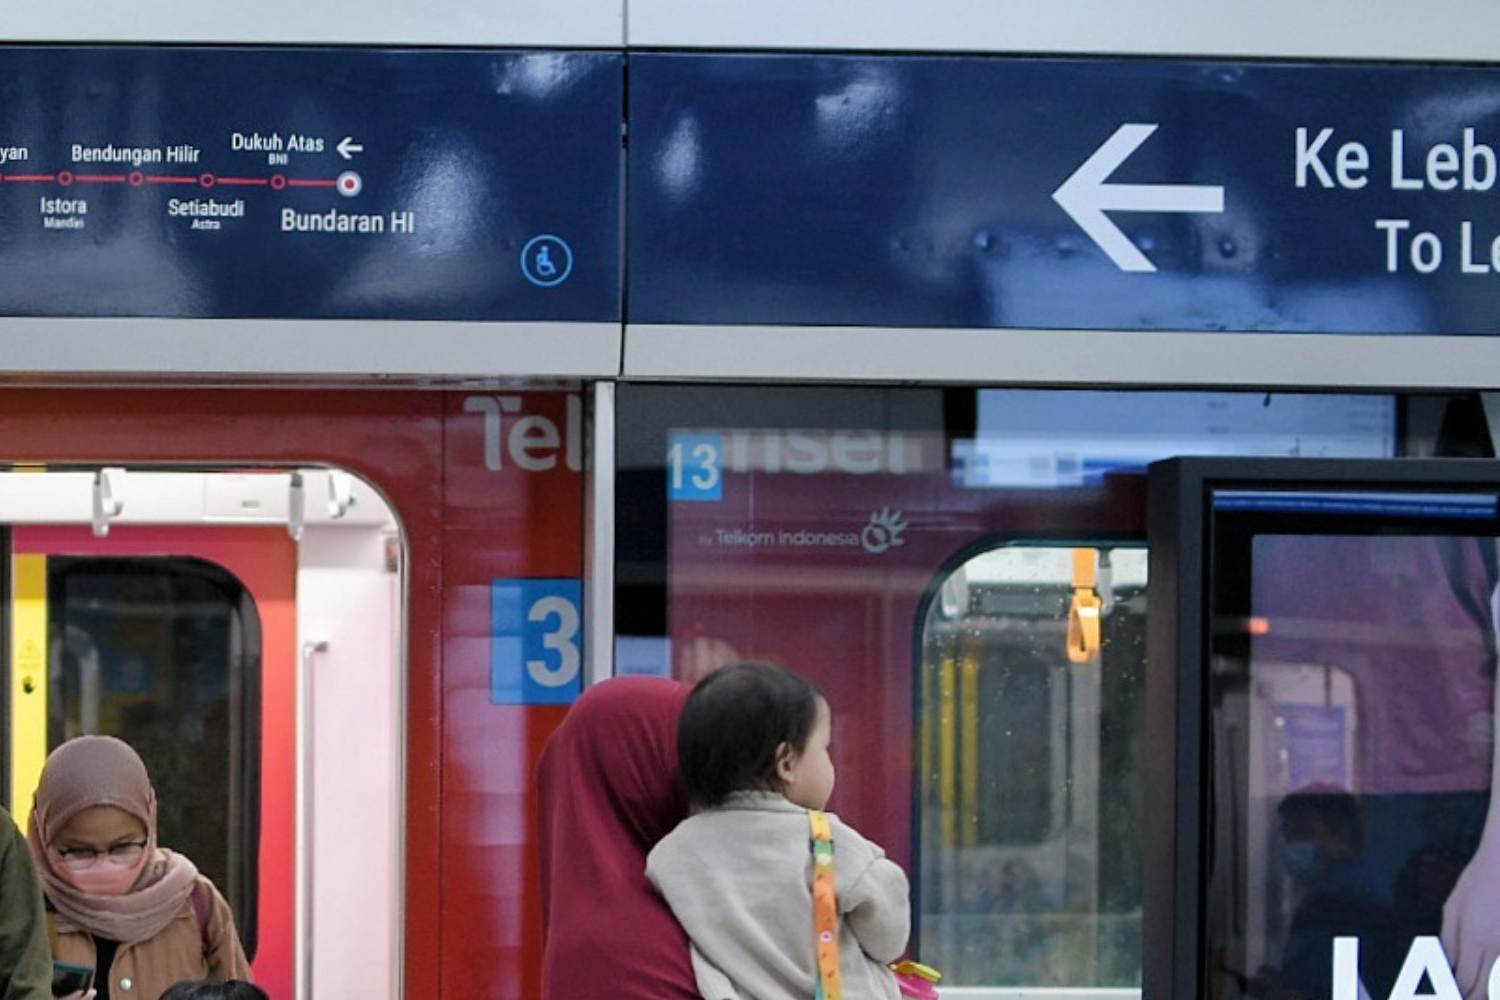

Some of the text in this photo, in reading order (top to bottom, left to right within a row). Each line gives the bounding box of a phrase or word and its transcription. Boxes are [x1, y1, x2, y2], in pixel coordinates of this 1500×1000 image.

[231, 133, 324, 153] Dukuh Atas
[71, 144, 201, 166] Bendungan Hilir
[268, 155, 288, 165] BNI
[1295, 127, 1498, 190] Ke Leb
[40, 197, 87, 214] Istora
[168, 198, 245, 218] Setiabudi
[282, 209, 415, 233] Bundaran HI
[1375, 219, 1442, 273] To
[667, 443, 719, 490] 13
[527, 597, 580, 688] 3
